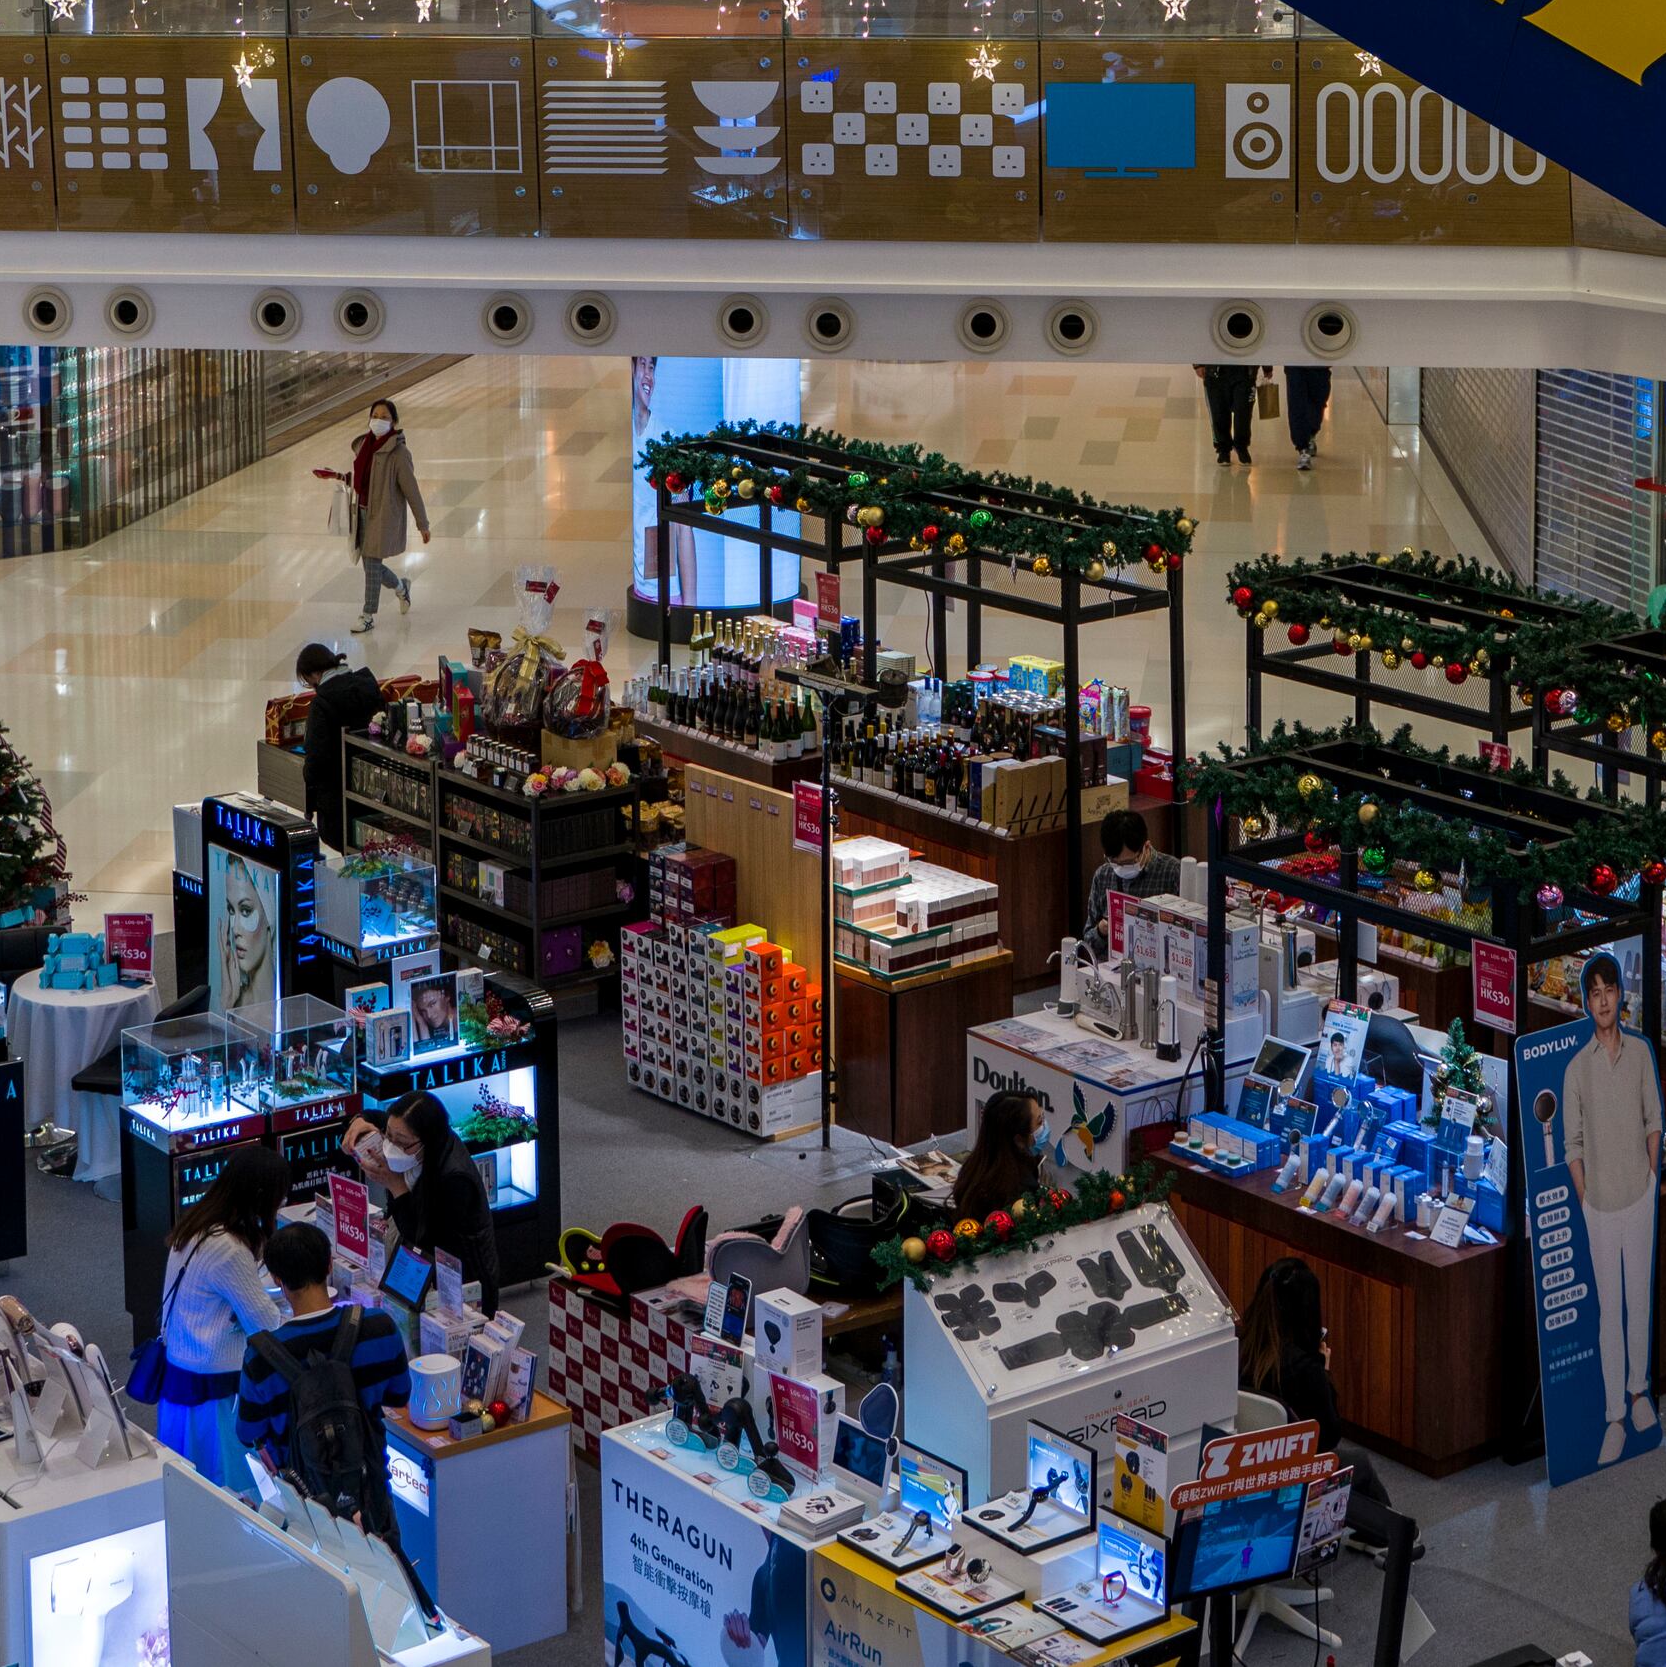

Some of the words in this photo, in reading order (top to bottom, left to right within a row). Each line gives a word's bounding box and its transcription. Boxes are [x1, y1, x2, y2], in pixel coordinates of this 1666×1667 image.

[216, 805, 273, 846] TALIKA
[297, 857, 317, 966] TALIKA
[118, 949, 147, 960] K$30
[321, 936, 352, 959] TALIKA
[376, 940, 423, 961] TALIKA
[1480, 987, 1510, 1007] HK$30
[1523, 1035, 1577, 1061] BODYLUV
[409, 1055, 501, 1091] TALIKA
[294, 1102, 345, 1121] TALIKA
[131, 1118, 156, 1142] TALIKA
[193, 1125, 239, 1145] TALIKA
[184, 1161, 228, 1182] TALI
[339, 1221, 365, 1243] HK$30
[1084, 1404, 1123, 1422] TRAINING
[1127, 1394, 1151, 1409] GEAR
[782, 1426, 814, 1453] HK$30
[1239, 1431, 1315, 1468] ZWIFT
[611, 1478, 733, 1572] THERAGUN
[629, 1532, 650, 1557] 4th
[651, 1543, 715, 1596] Generation
[839, 1595, 912, 1639] AMAZFIT
[823, 1619, 883, 1667] AirRun
